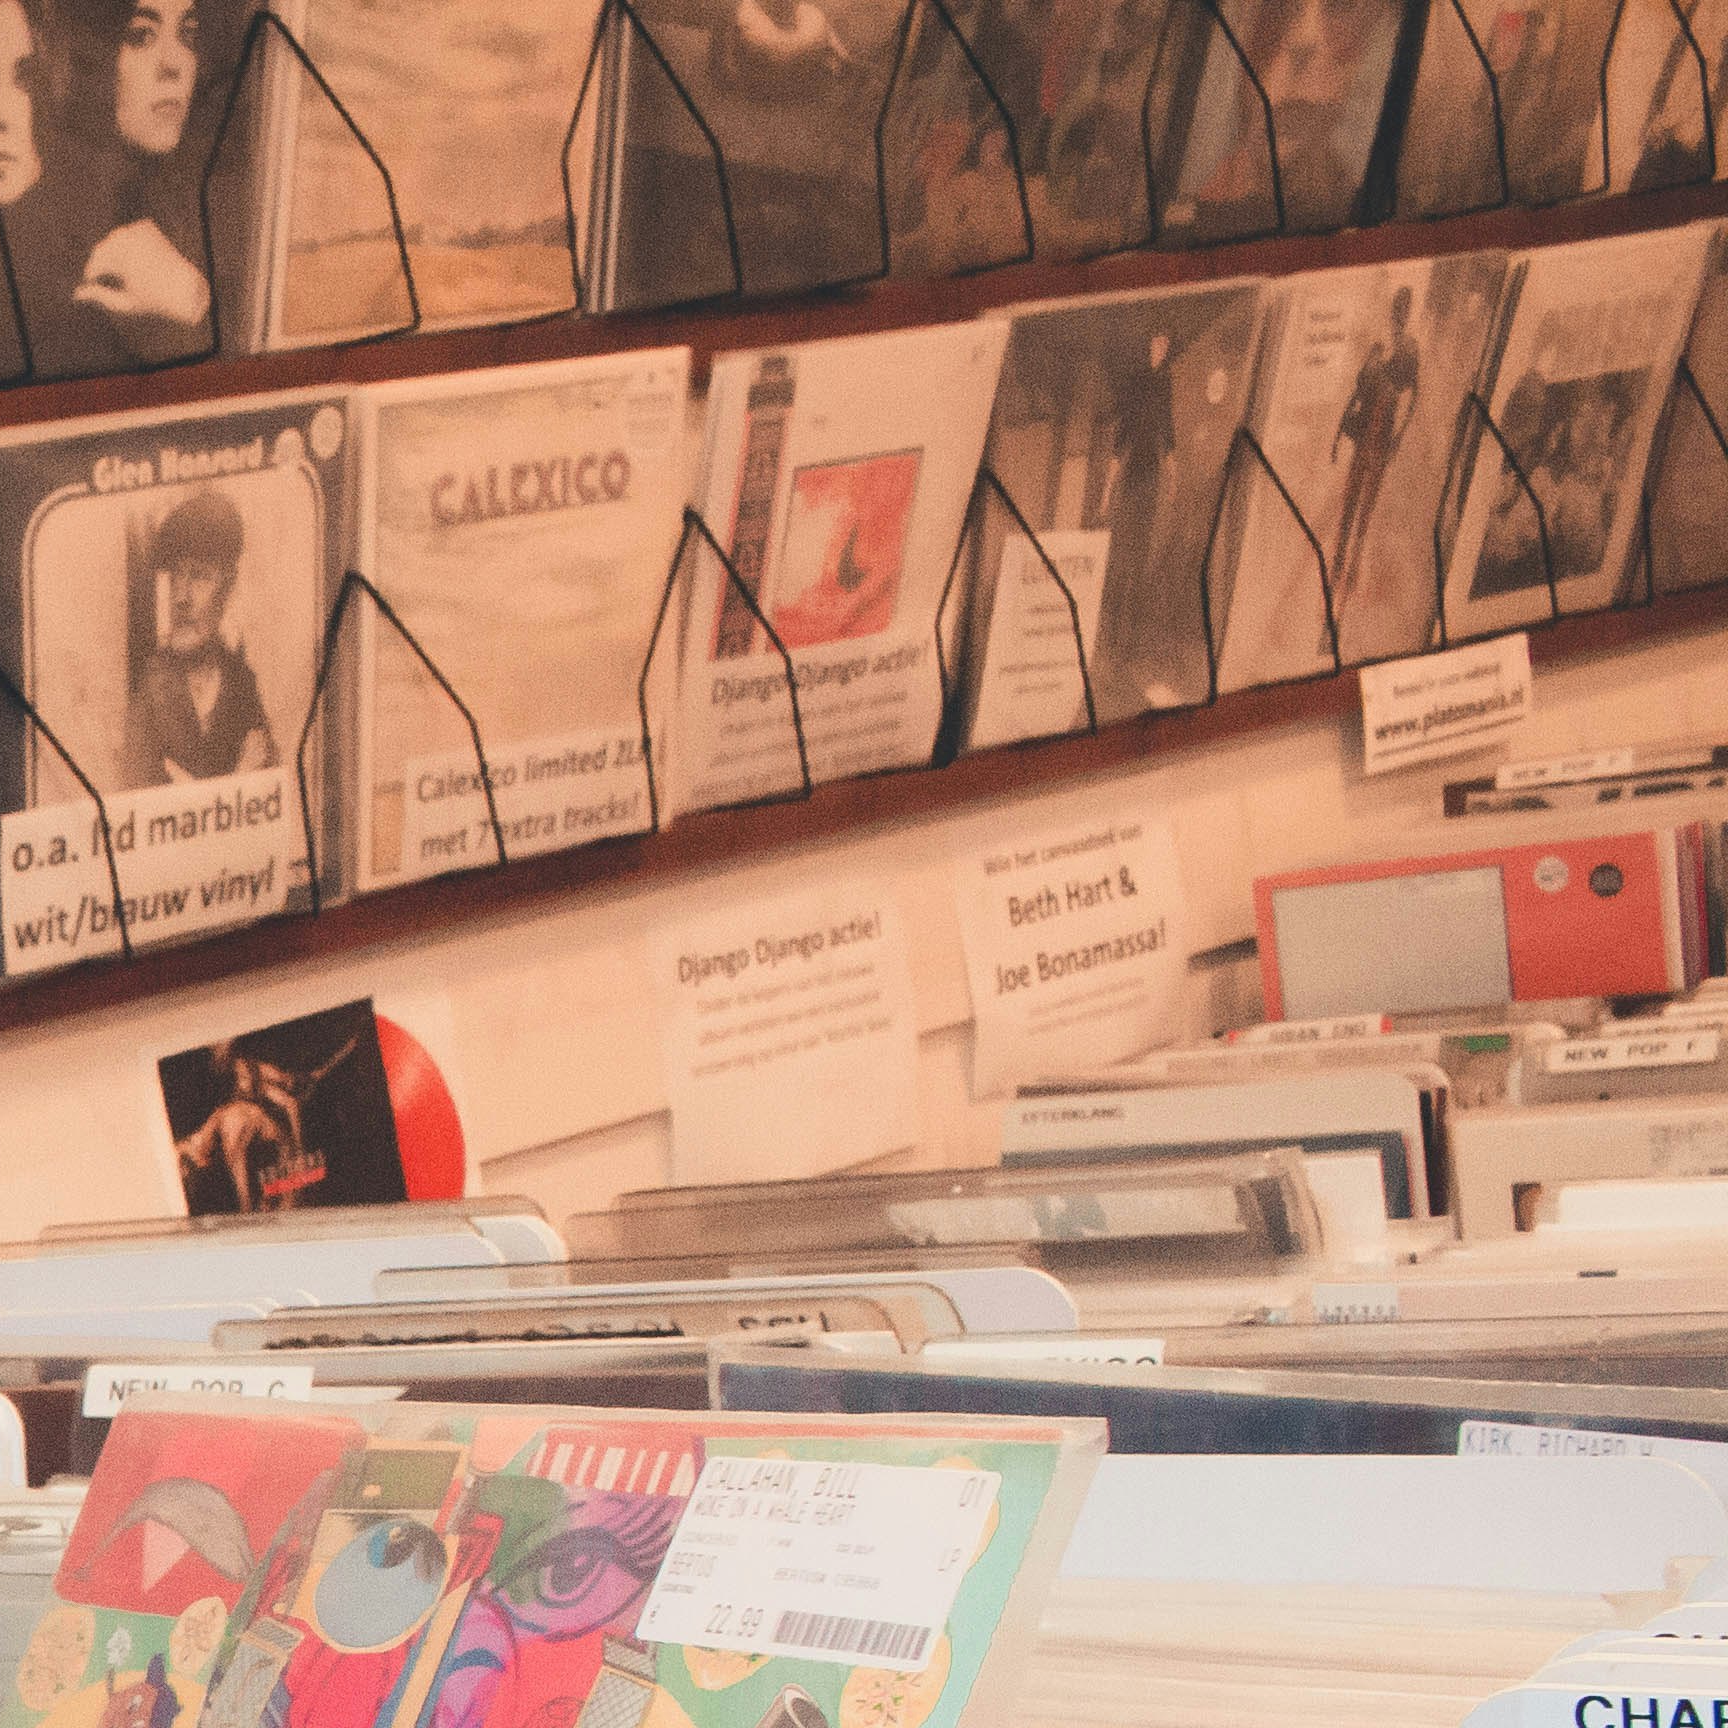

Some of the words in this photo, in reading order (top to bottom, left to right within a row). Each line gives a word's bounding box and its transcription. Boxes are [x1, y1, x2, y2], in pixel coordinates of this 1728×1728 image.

[429, 451, 632, 529] CALEXICO
[524, 741, 609, 783] limited
[11, 834, 81, 873] o.a.
[147, 781, 284, 844] marbled
[420, 828, 469, 858] met
[199, 855, 276, 908] vinyl
[1007, 885, 1061, 929] Beth
[1064, 874, 1115, 913] Hart
[1117, 863, 1139, 899] &
[677, 945, 751, 989] Django
[754, 930, 825, 970] Django
[828, 908, 883, 949] actie!
[994, 962, 1033, 997] Joe
[1034, 915, 1168, 984] Bonamassa!
[1563, 1044, 1608, 1063] NEW
[705, 1461, 798, 1499] CALLAHAN,
[812, 1466, 863, 1499] BILL
[703, 1603, 767, 1639] 22.99
